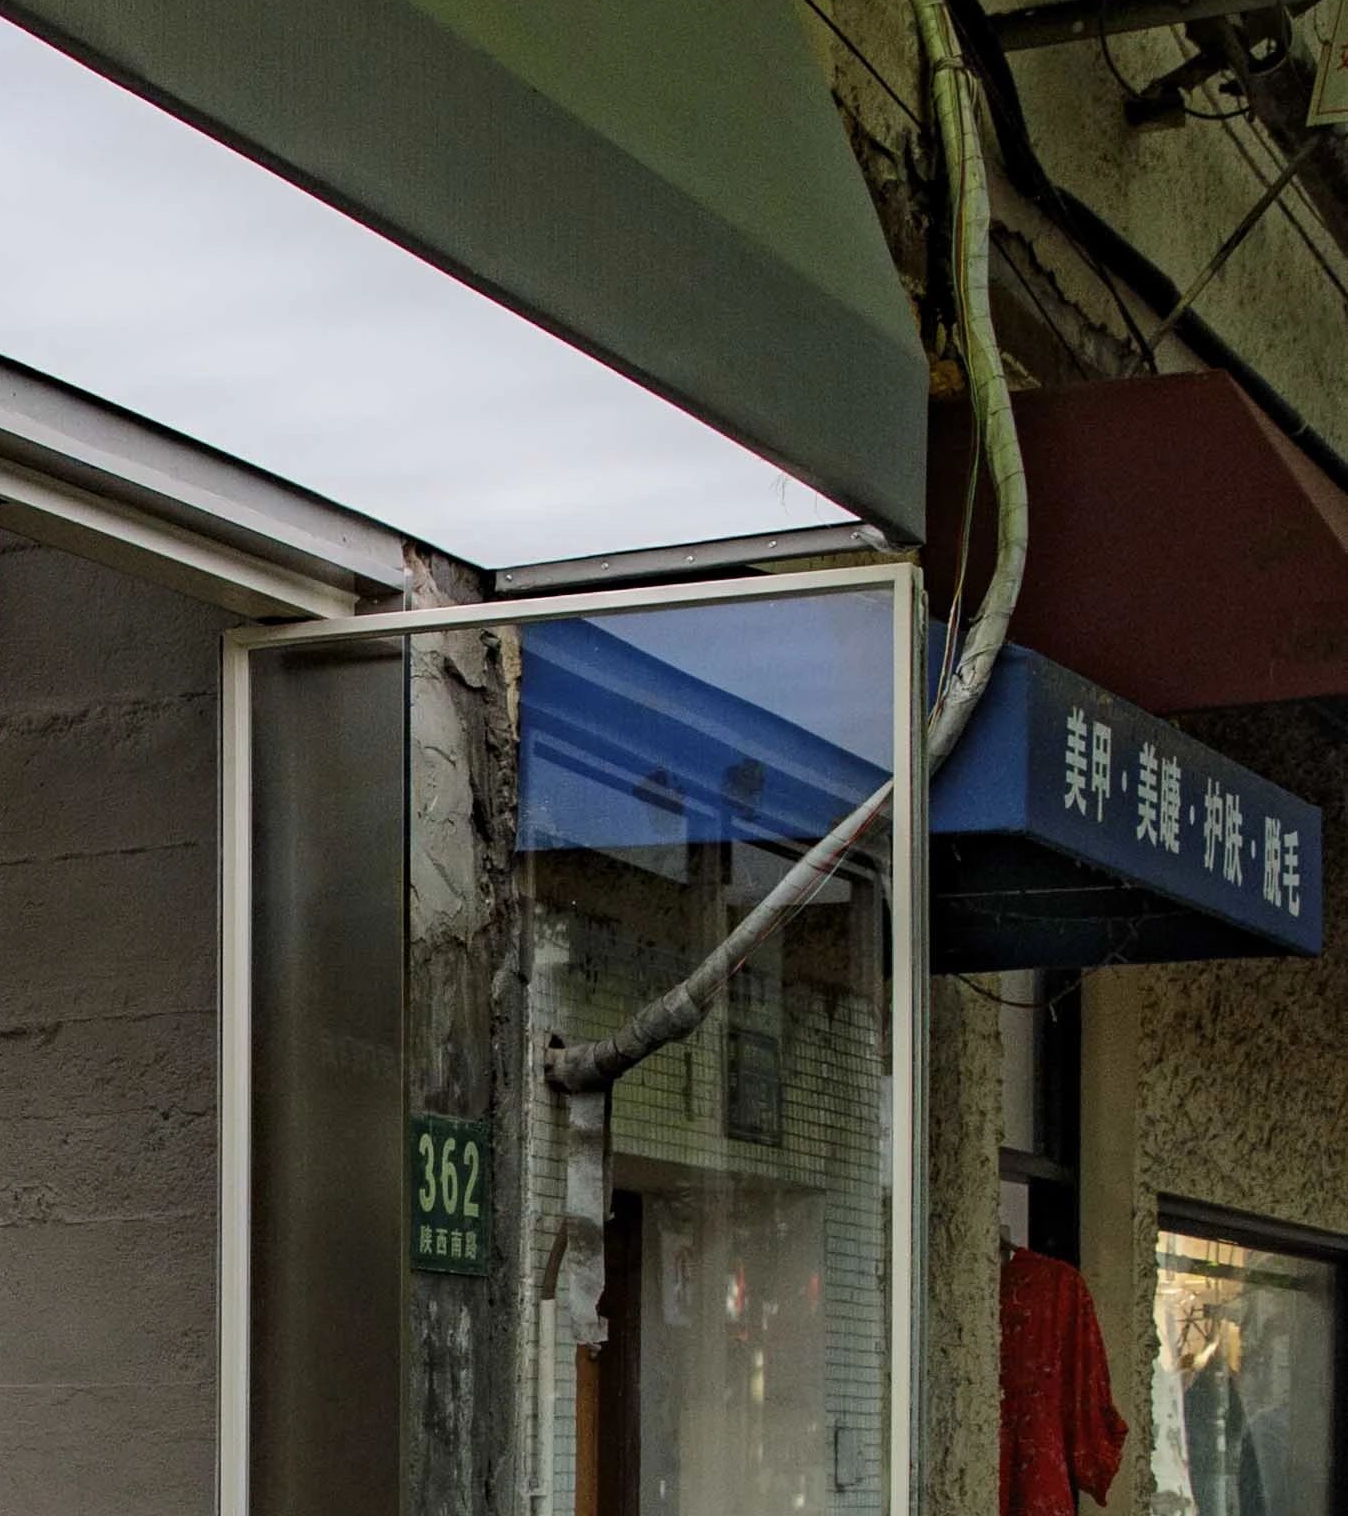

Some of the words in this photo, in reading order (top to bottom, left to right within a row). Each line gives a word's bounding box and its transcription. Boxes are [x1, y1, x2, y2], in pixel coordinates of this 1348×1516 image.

[418, 1132, 480, 1218] 362
[418, 1224, 478, 1261] 陕西南路
